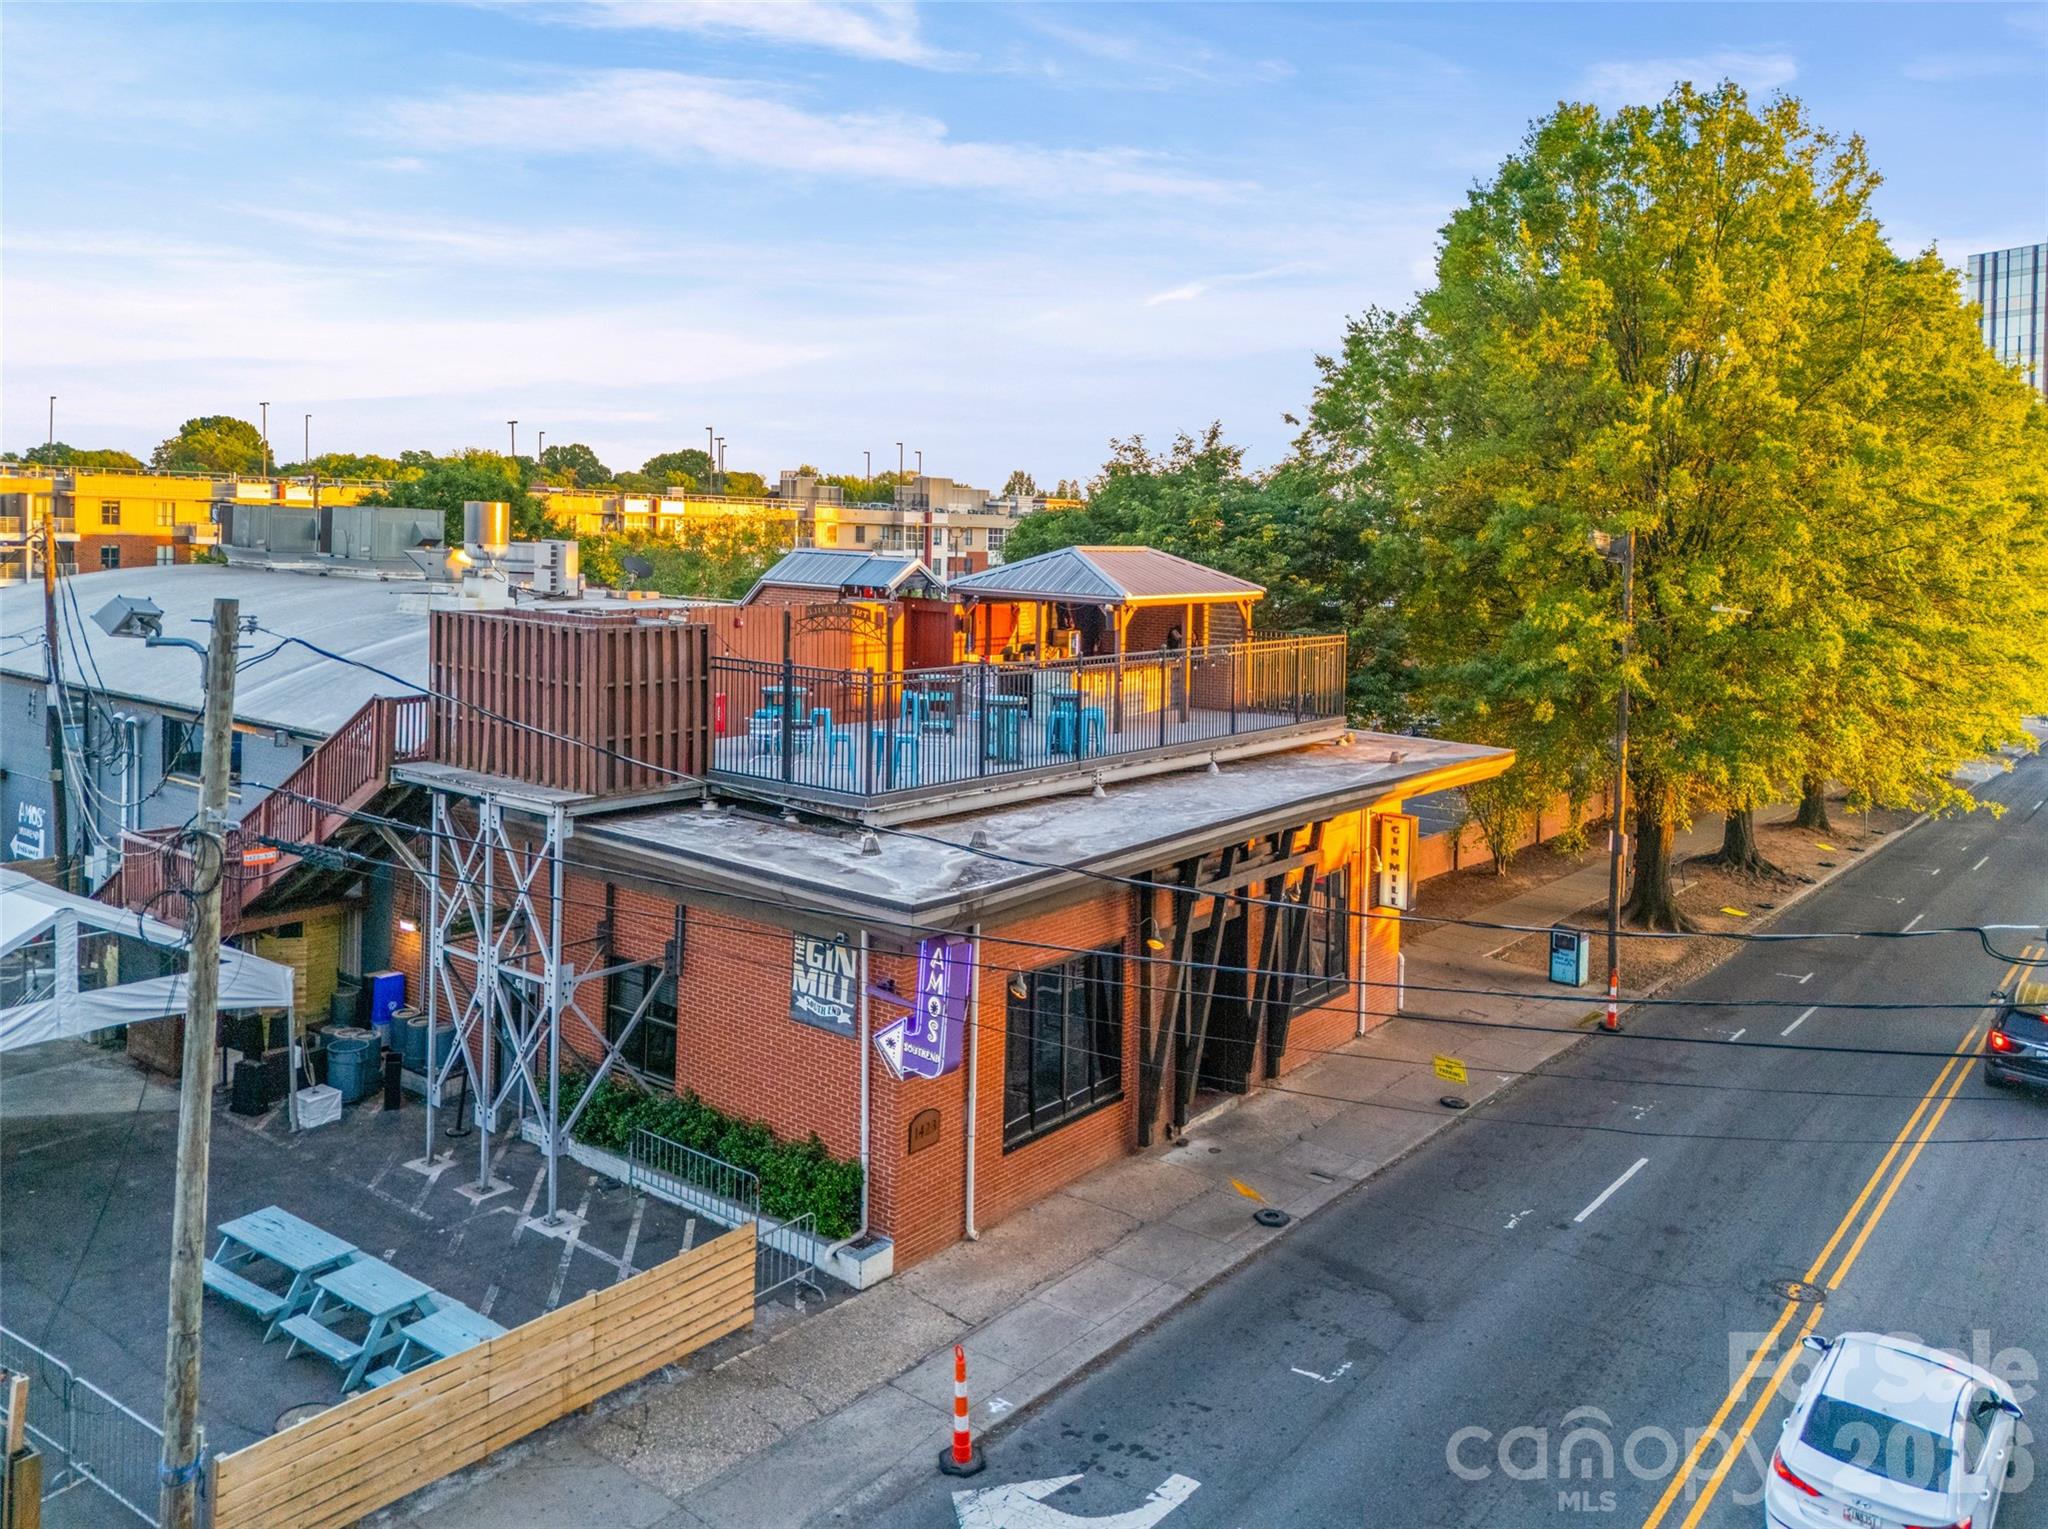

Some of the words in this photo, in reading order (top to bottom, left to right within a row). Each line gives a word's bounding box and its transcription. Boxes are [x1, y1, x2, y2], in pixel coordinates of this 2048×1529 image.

[1390, 825, 1401, 856] GIN
[1388, 862, 1401, 906] MILL
[795, 935, 806, 962] THE
[806, 940, 858, 978] GIN
[792, 962, 855, 1008] MILL
[925, 947, 945, 1043] AMOS
[806, 998, 826, 1016] SOUTH
[827, 1005, 842, 1017] END
